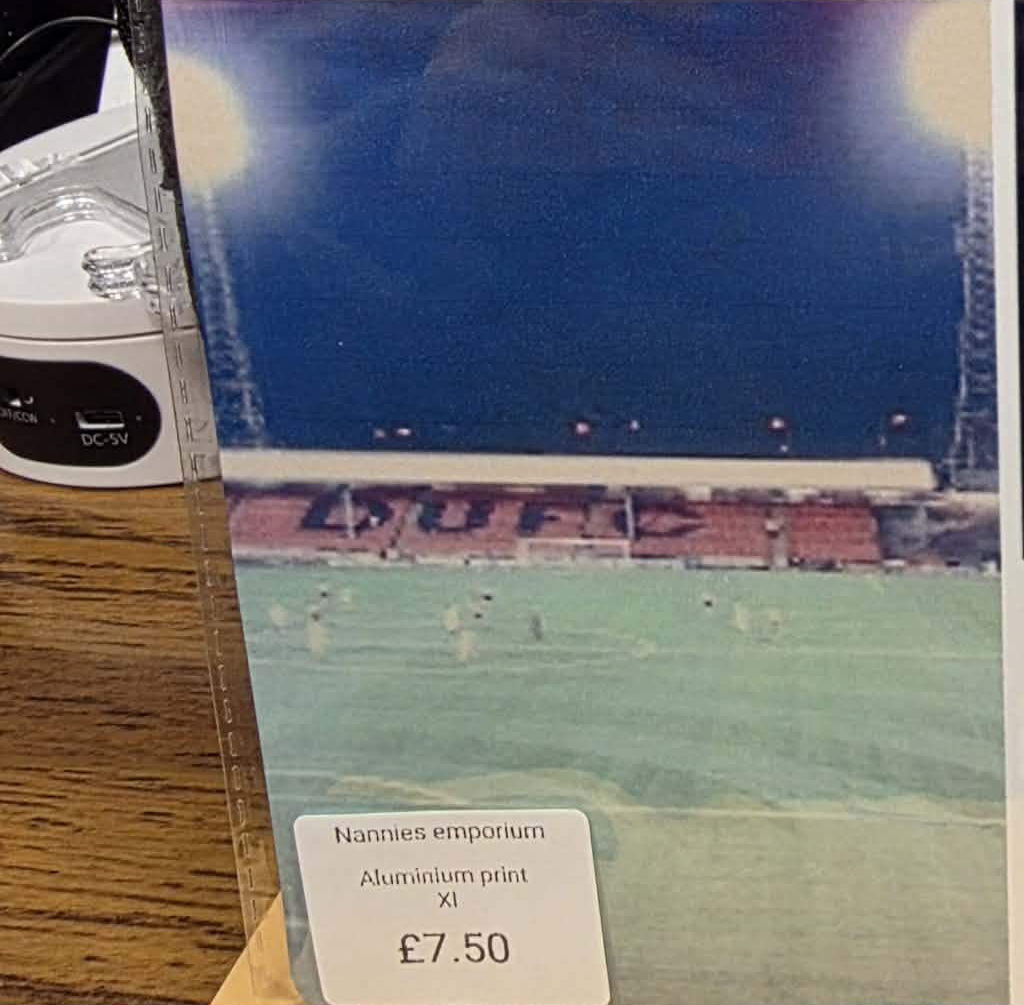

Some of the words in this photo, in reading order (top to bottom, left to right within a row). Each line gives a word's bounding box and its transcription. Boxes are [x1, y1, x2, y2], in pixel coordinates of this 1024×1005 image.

[80, 432, 129, 446] DC-5V
[334, 826, 427, 844] Nannies
[432, 825, 546, 844] emporium
[360, 867, 474, 887] Aluminium
[480, 865, 528, 887] print
[398, 932, 510, 965] £7.50
